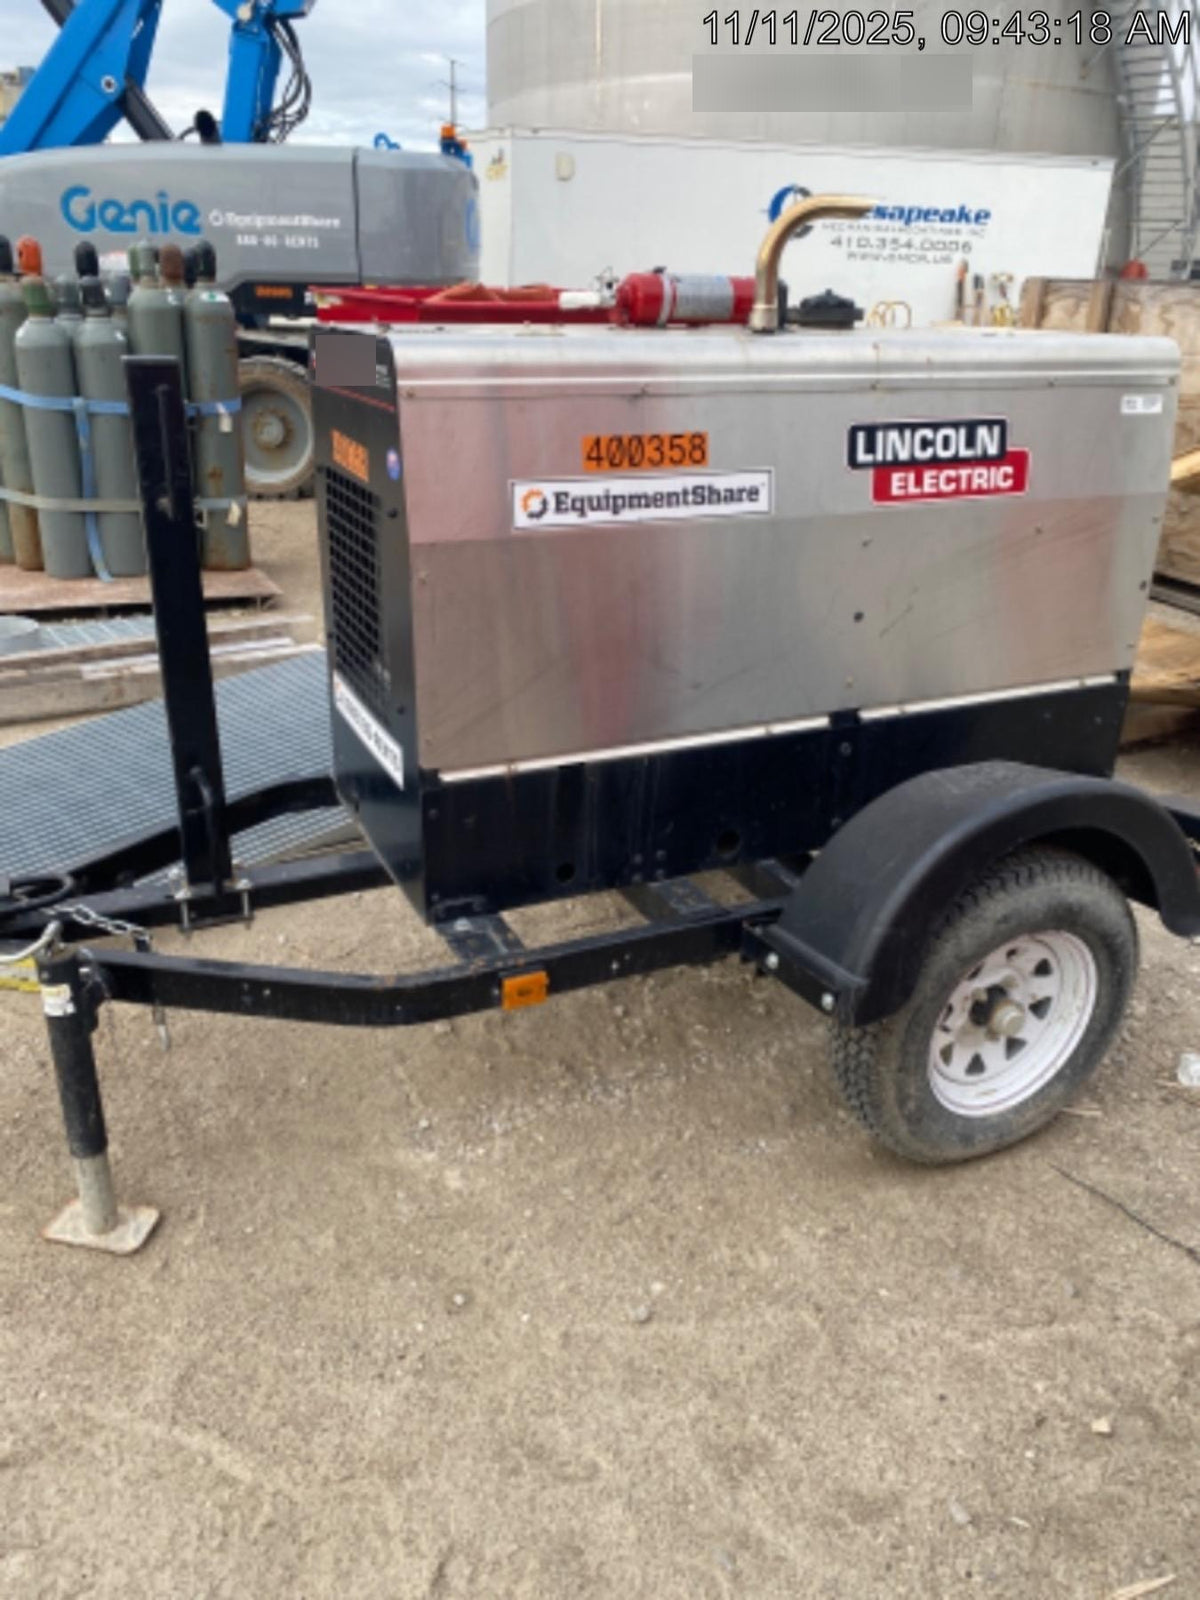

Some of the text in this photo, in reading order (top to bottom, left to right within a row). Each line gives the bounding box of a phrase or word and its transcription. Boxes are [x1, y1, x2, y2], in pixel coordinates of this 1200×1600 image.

[60, 184, 202, 236] Genie
[585, 433, 708, 469] 400358
[855, 424, 1001, 465] LINCOLN
[890, 464, 1015, 497] ELECTRIC
[552, 483, 761, 517] EquipmentShare
